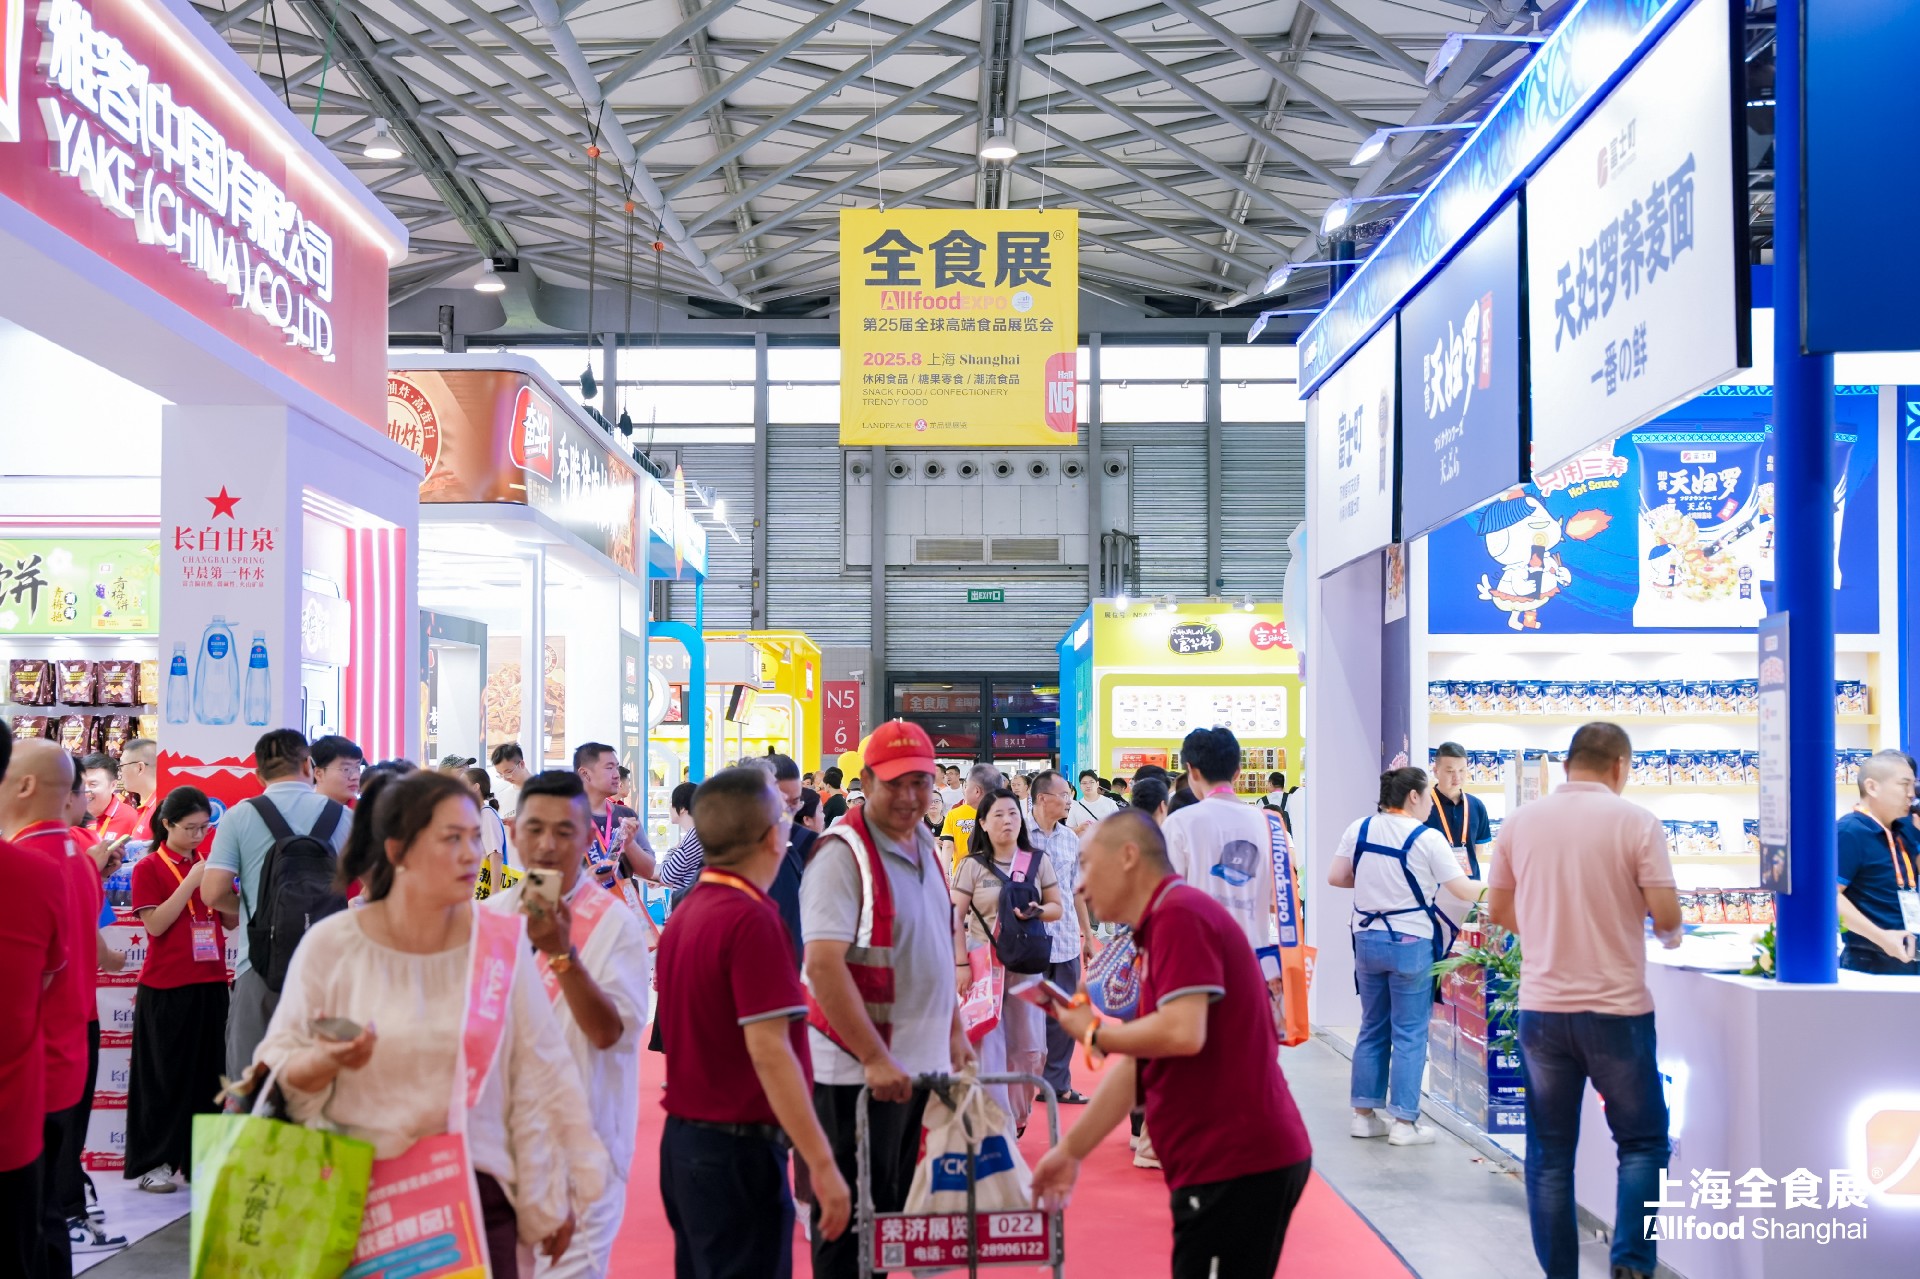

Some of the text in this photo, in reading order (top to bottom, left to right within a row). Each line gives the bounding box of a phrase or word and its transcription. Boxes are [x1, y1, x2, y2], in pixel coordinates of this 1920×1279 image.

[49, 97, 136, 220] YAKE
[863, 229, 1052, 289] 全食展
[1554, 152, 1697, 352] 天妇罗荞麦面
[863, 317, 1054, 332] 第25届全球高端食品展览会
[863, 352, 1020, 367] 2025.8 上海 Shanghai
[862, 373, 909, 385] 休闲食品
[918, 373, 964, 385] 糖果零食
[973, 373, 1020, 385] 潮流食品
[1057, 370, 1074, 379] Hall
[862, 388, 894, 396] SNACK
[896, 388, 923, 396] FOOD
[930, 388, 1009, 396] CONFECTIONERY
[1048, 381, 1074, 414] N5
[1567, 480, 1619, 498] Hot Sauce
[171, 526, 275, 552] 长白甘泉
[182, 556, 265, 565] CHANGBAI SPRING
[182, 566, 265, 581] 早晨第一杯水
[827, 690, 855, 709] N5
[834, 726, 847, 745] 6
[881, 1217, 968, 1243] 荣济展览
[998, 1217, 1034, 1233] 022
